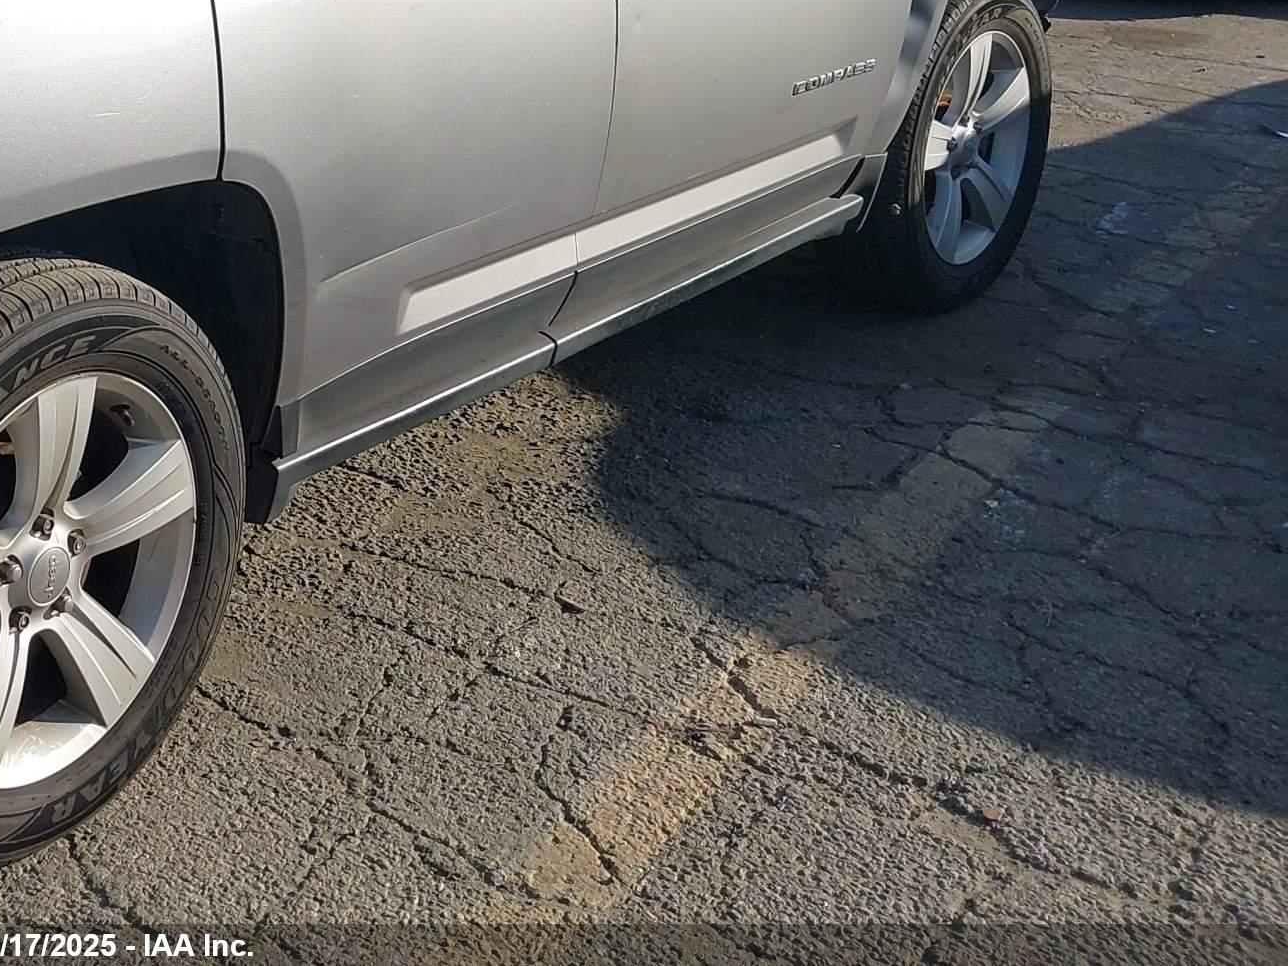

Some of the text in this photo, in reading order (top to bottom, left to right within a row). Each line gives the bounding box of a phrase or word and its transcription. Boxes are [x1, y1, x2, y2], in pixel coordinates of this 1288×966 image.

[791, 57, 877, 97] COMPASS
[43, 554, 60, 599] Jeep
[50, 567, 222, 824] GOODYEAR
